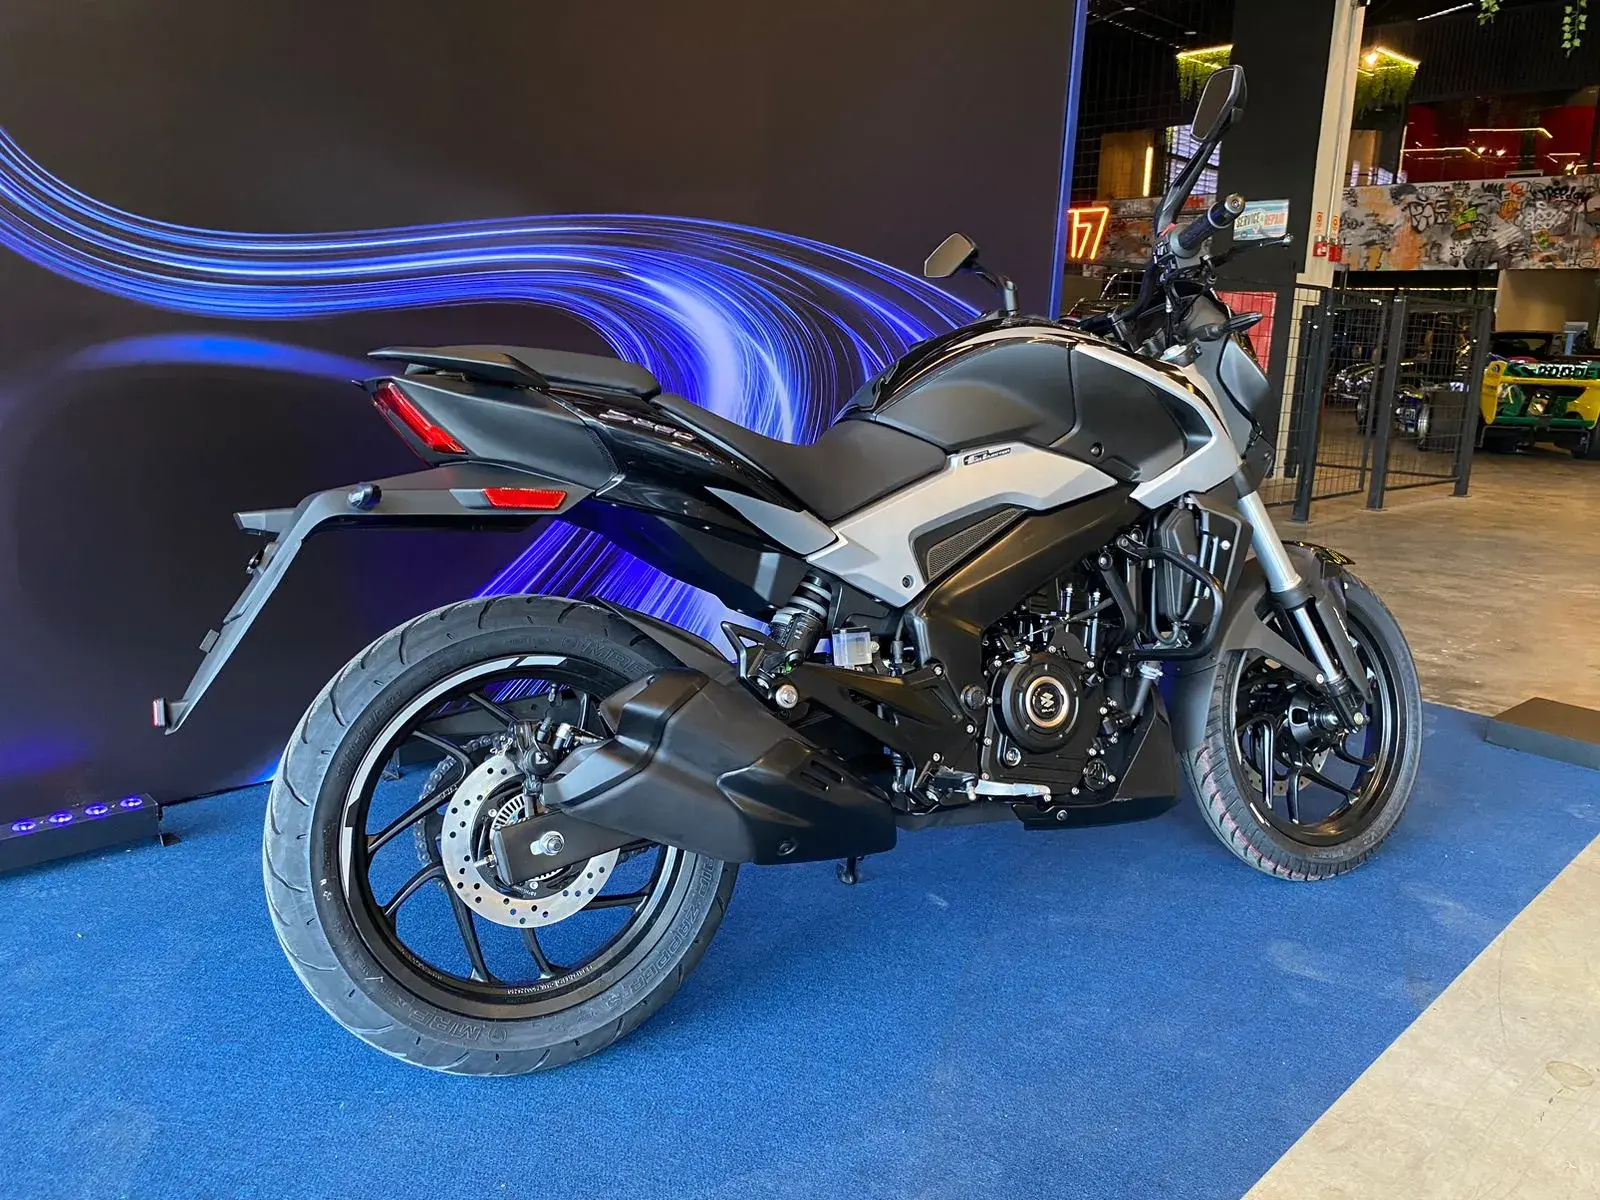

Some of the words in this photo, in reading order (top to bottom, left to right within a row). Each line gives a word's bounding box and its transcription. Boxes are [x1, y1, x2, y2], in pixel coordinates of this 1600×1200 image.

[1235, 211, 1261, 228] SERVICE
[1263, 212, 1285, 226] REPAIR
[407, 1006, 482, 1042] MRF
